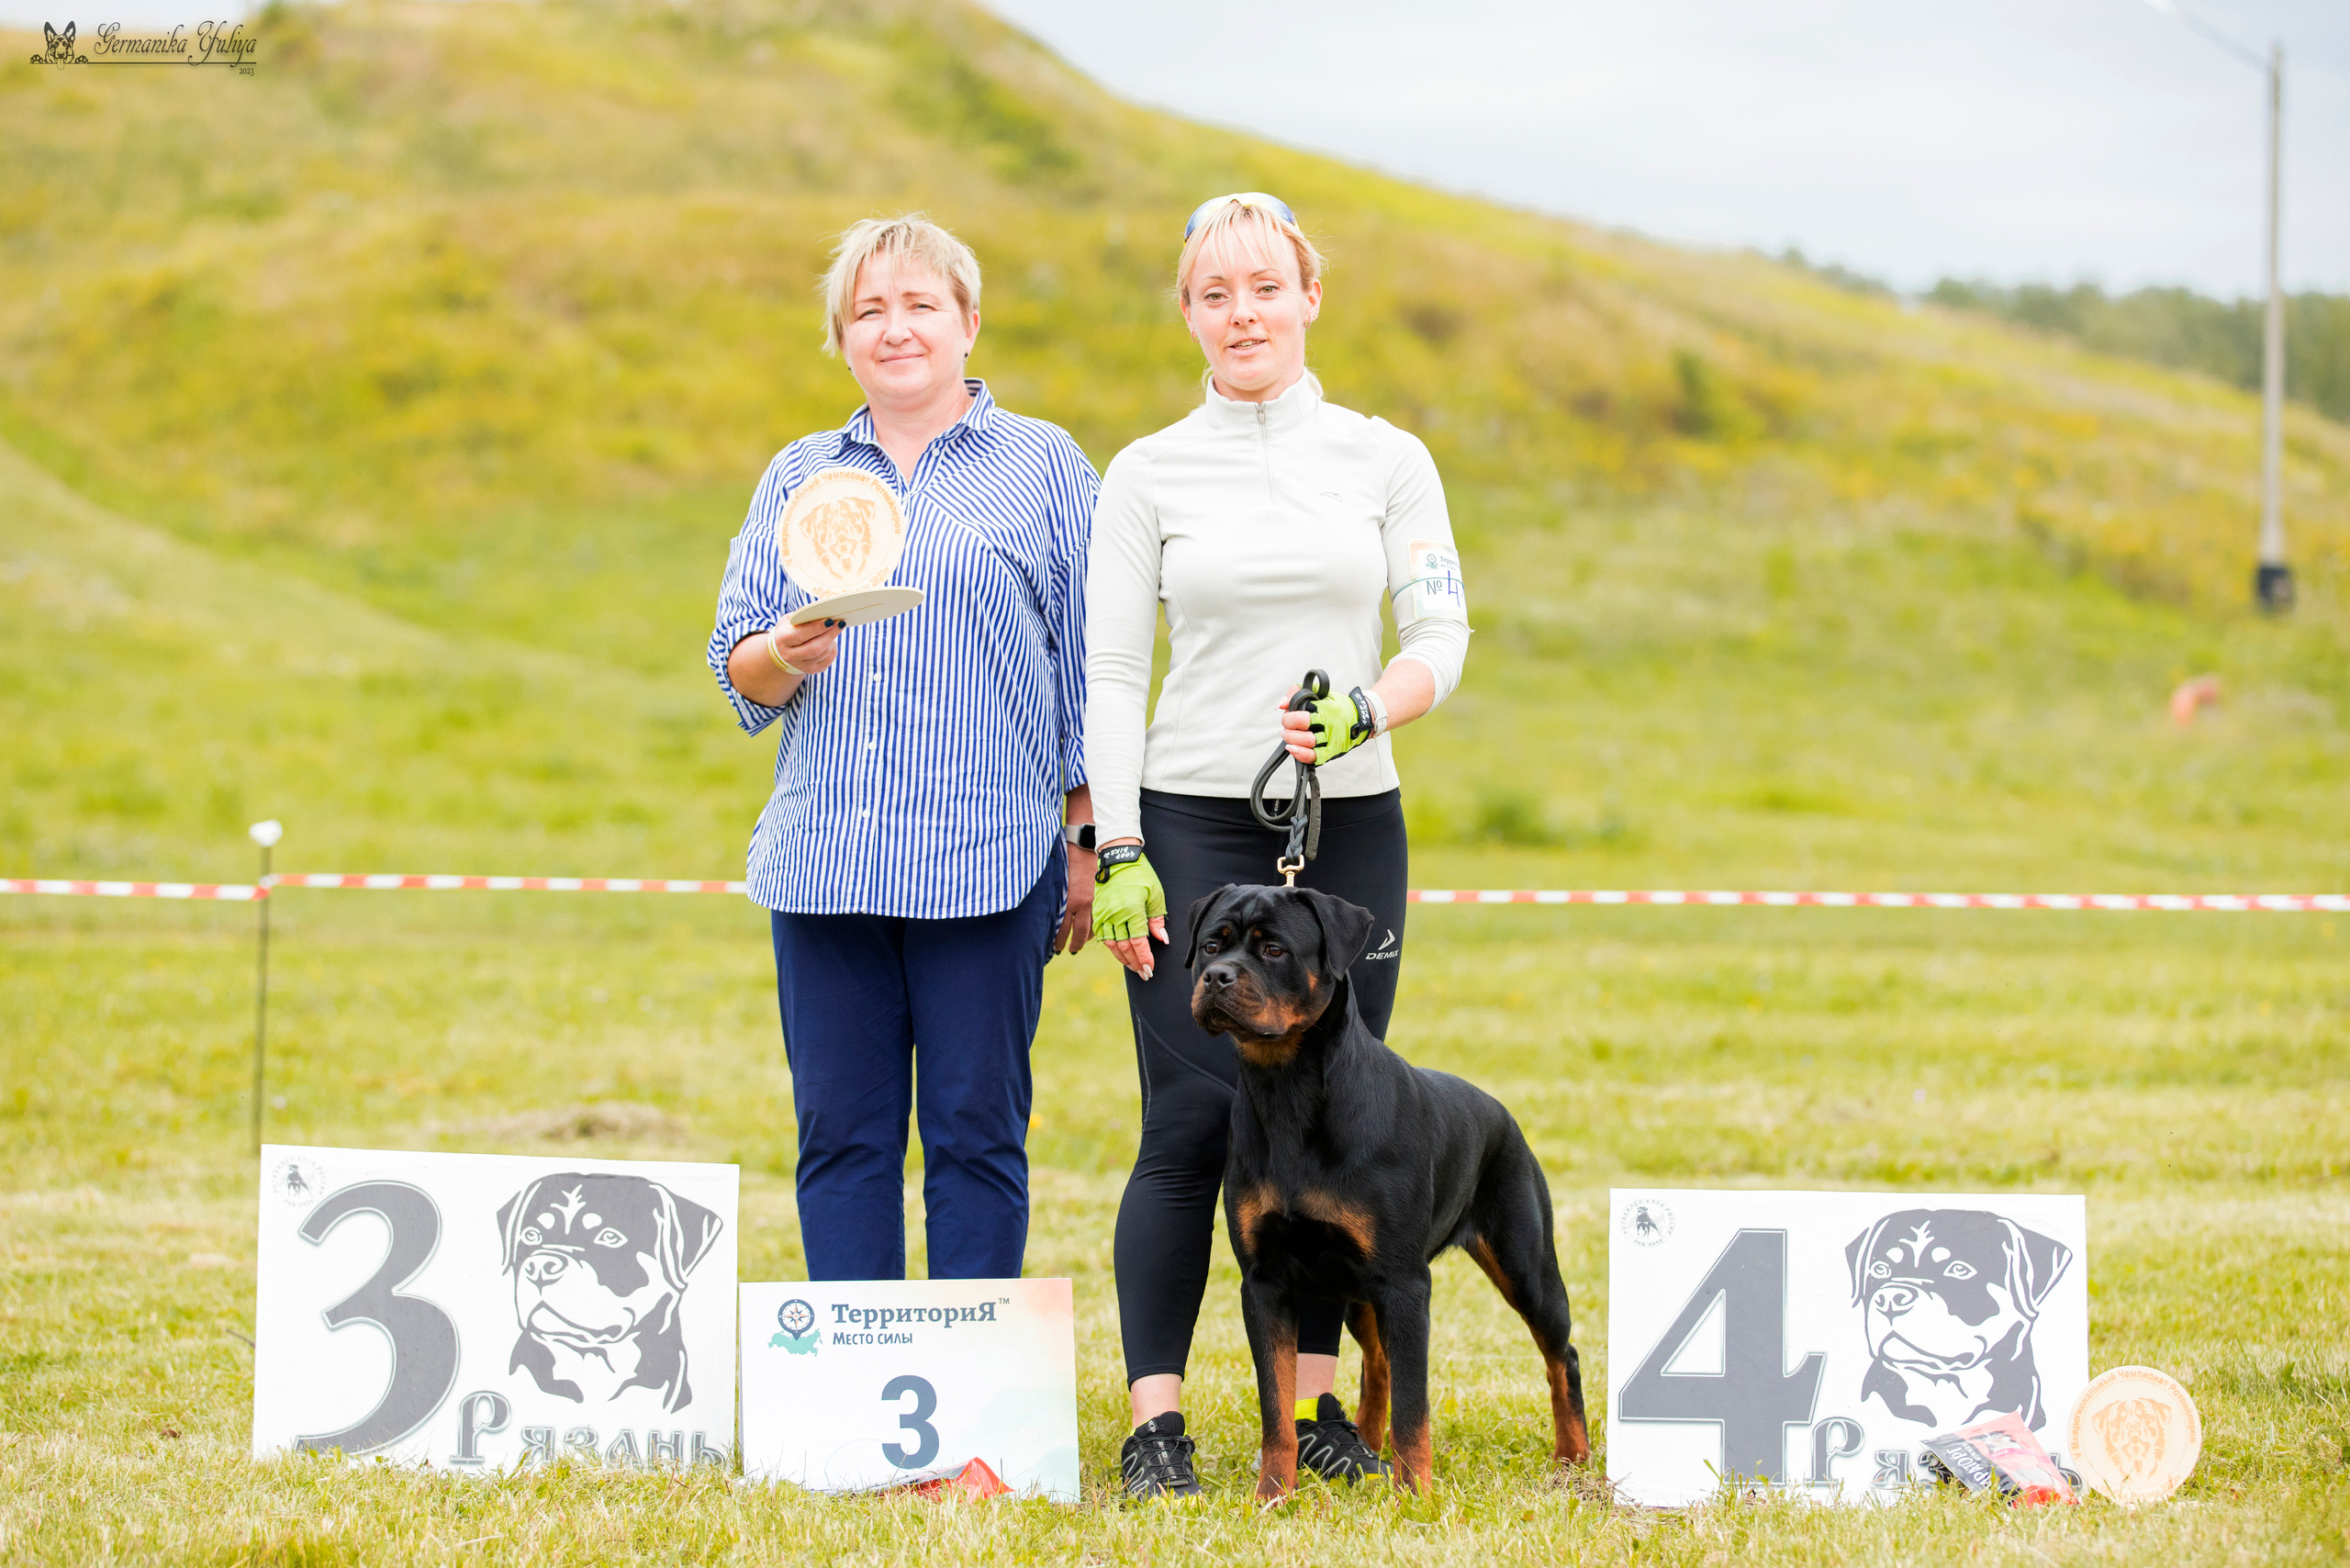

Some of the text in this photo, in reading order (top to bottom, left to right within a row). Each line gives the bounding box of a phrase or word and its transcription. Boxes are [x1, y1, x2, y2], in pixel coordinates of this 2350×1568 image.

[822, 471, 871, 484] Чемпионат
[870, 478, 901, 534] Ротвейлеров
[1365, 949, 1399, 960] DEMIX
[297, 1179, 461, 1455] 3
[831, 1301, 997, 1329] ТерриториЯ
[1618, 1227, 1827, 1487] 4
[881, 1374, 940, 1469] 3
[2071, 1372, 2117, 1450] Межрегиональный
[2118, 1369, 2168, 1387] Чемпионат
[2168, 1383, 2197, 1444] Ротвейлеров
